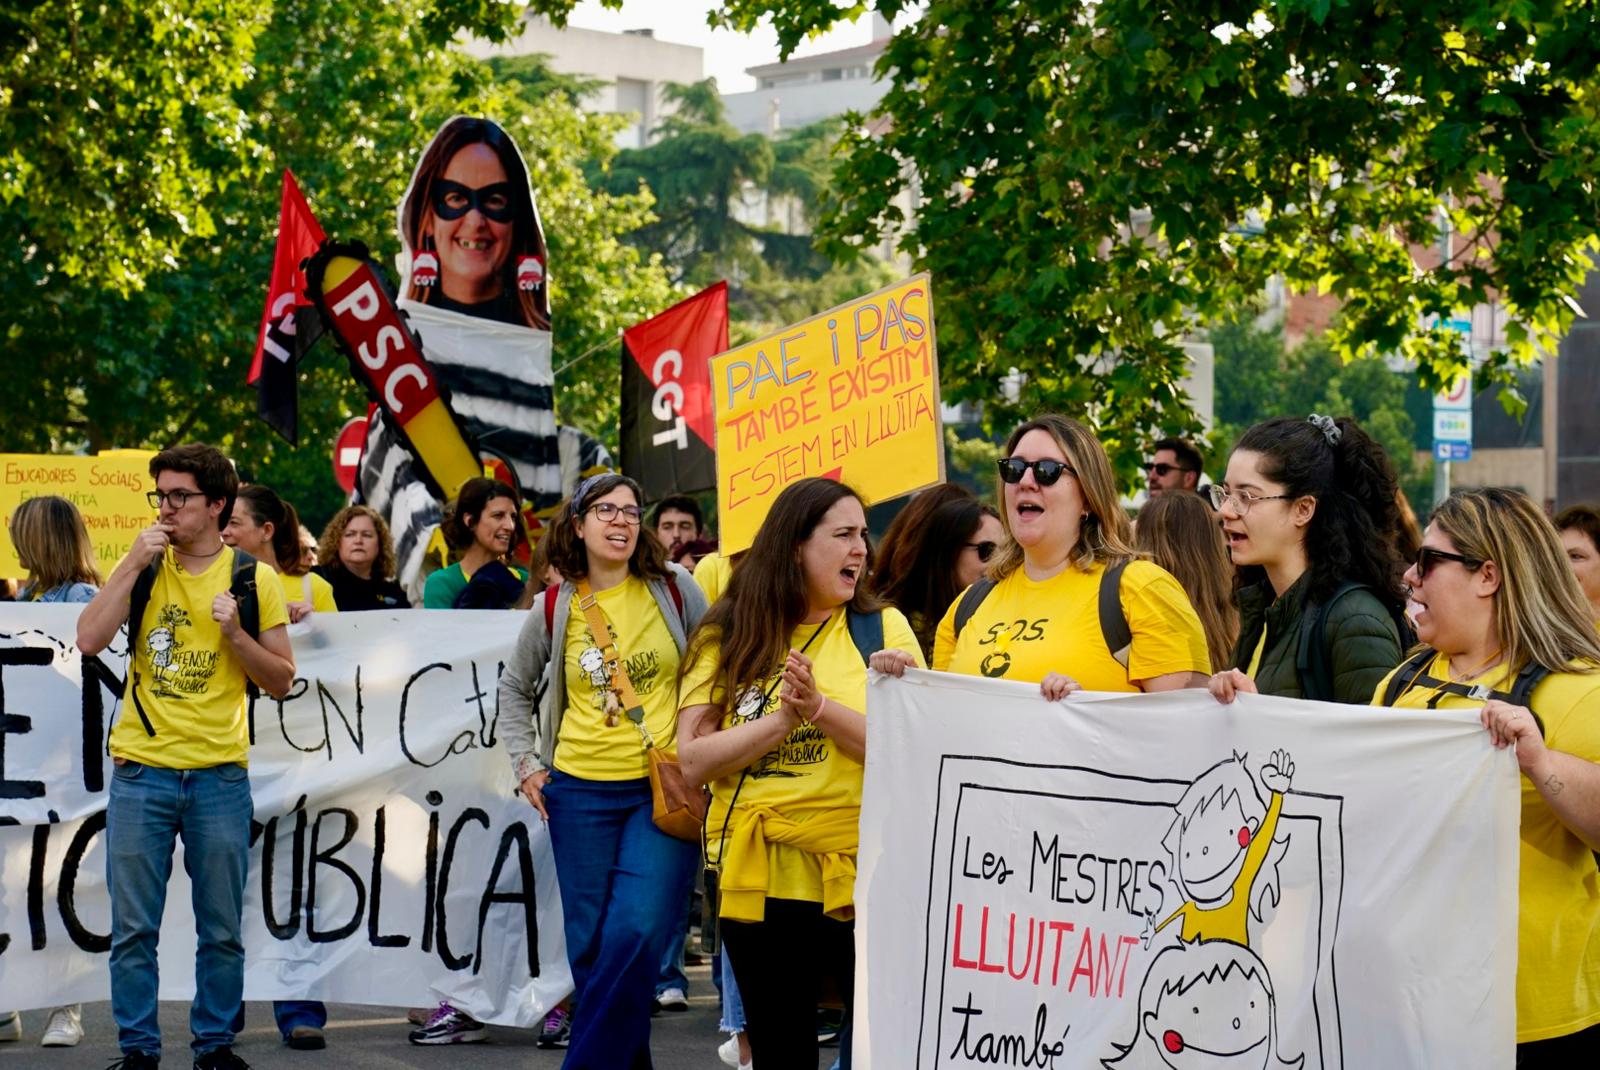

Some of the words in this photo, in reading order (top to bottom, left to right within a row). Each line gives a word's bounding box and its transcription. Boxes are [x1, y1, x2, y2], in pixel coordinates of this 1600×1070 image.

[414, 275, 437, 286] CGT
[519, 280, 541, 290] CGT
[331, 280, 429, 413] PSC
[726, 332, 812, 411] PAE
[854, 288, 927, 360] PAS
[651, 349, 689, 450] CGT
[725, 370, 821, 452] TAMBÉ
[728, 434, 823, 510] ESTEM
[831, 419, 858, 461] EN
[962, 835, 1014, 885] Les
[1028, 830, 1166, 917] MESTRES
[951, 903, 1140, 999] LLUITANT
[950, 991, 1071, 1069] també
